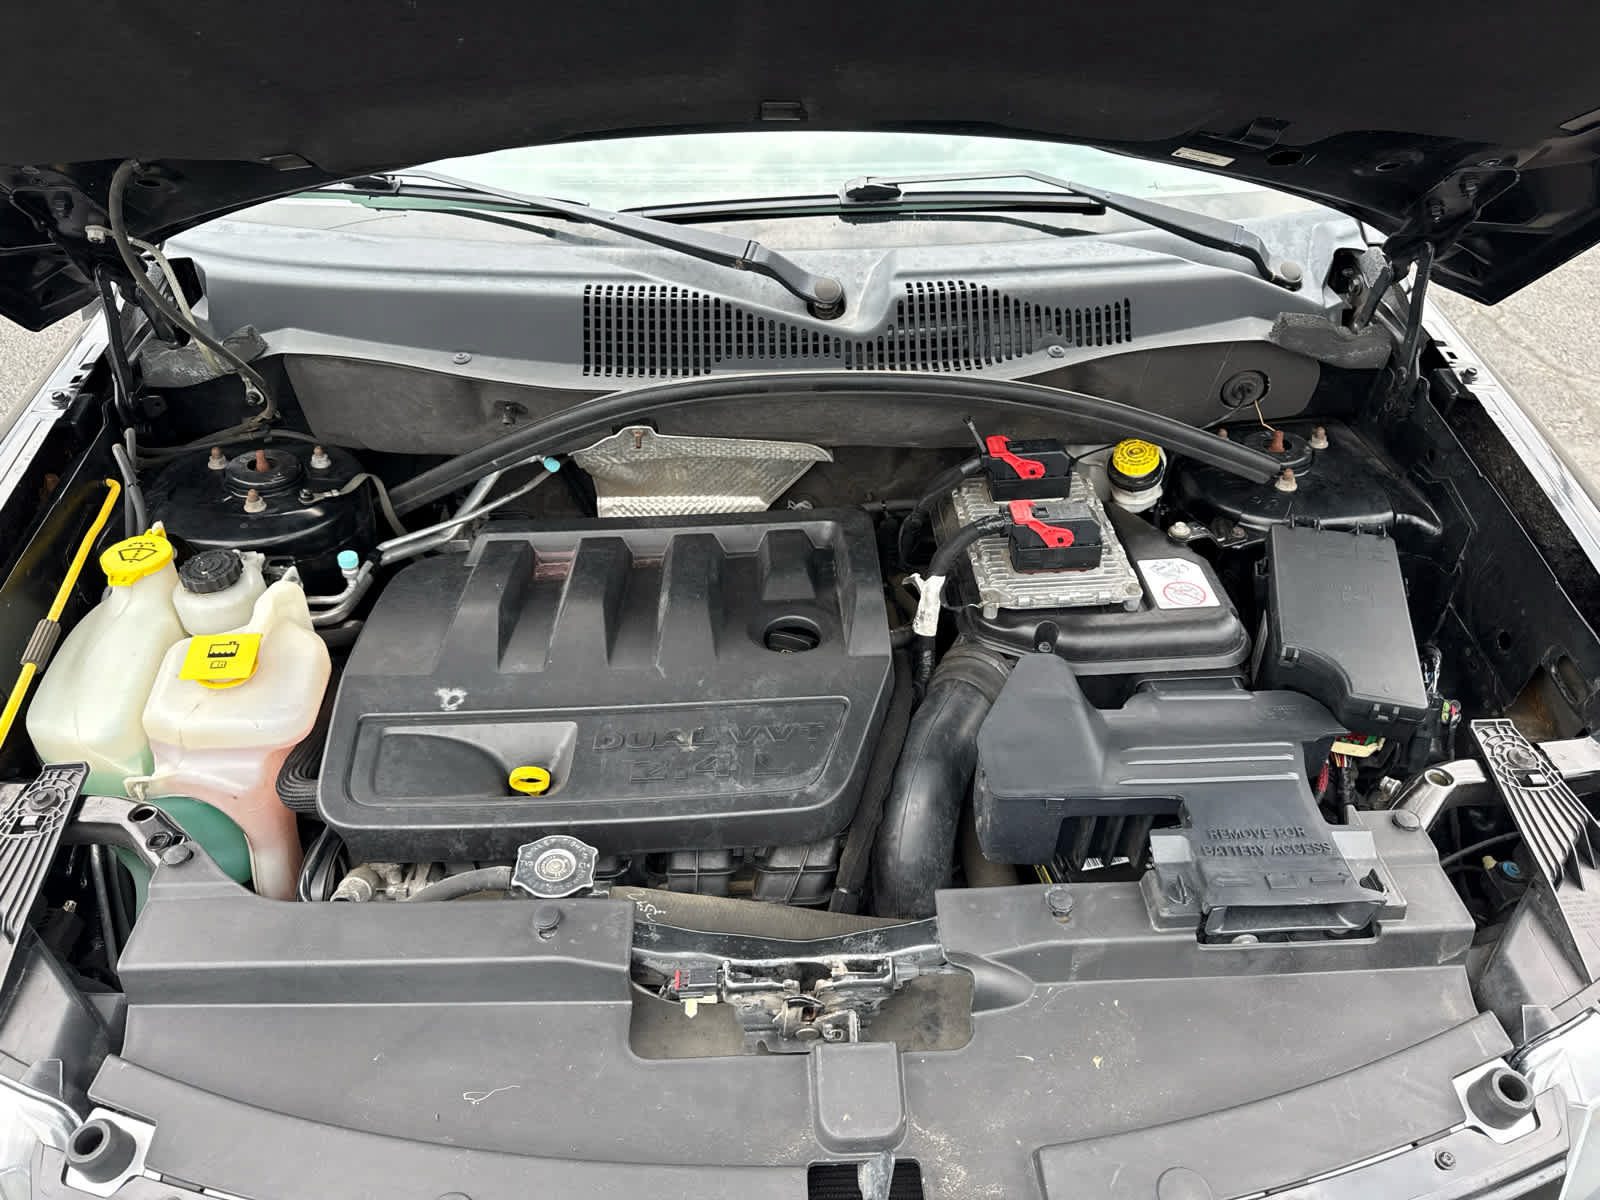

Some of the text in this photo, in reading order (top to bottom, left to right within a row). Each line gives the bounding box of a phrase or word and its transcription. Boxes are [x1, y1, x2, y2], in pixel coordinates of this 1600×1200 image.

[592, 722, 826, 752] DUAL VVT
[1207, 825, 1306, 841] REMOVE FOR
[1200, 841, 1333, 857] BATTERY ACCESS
